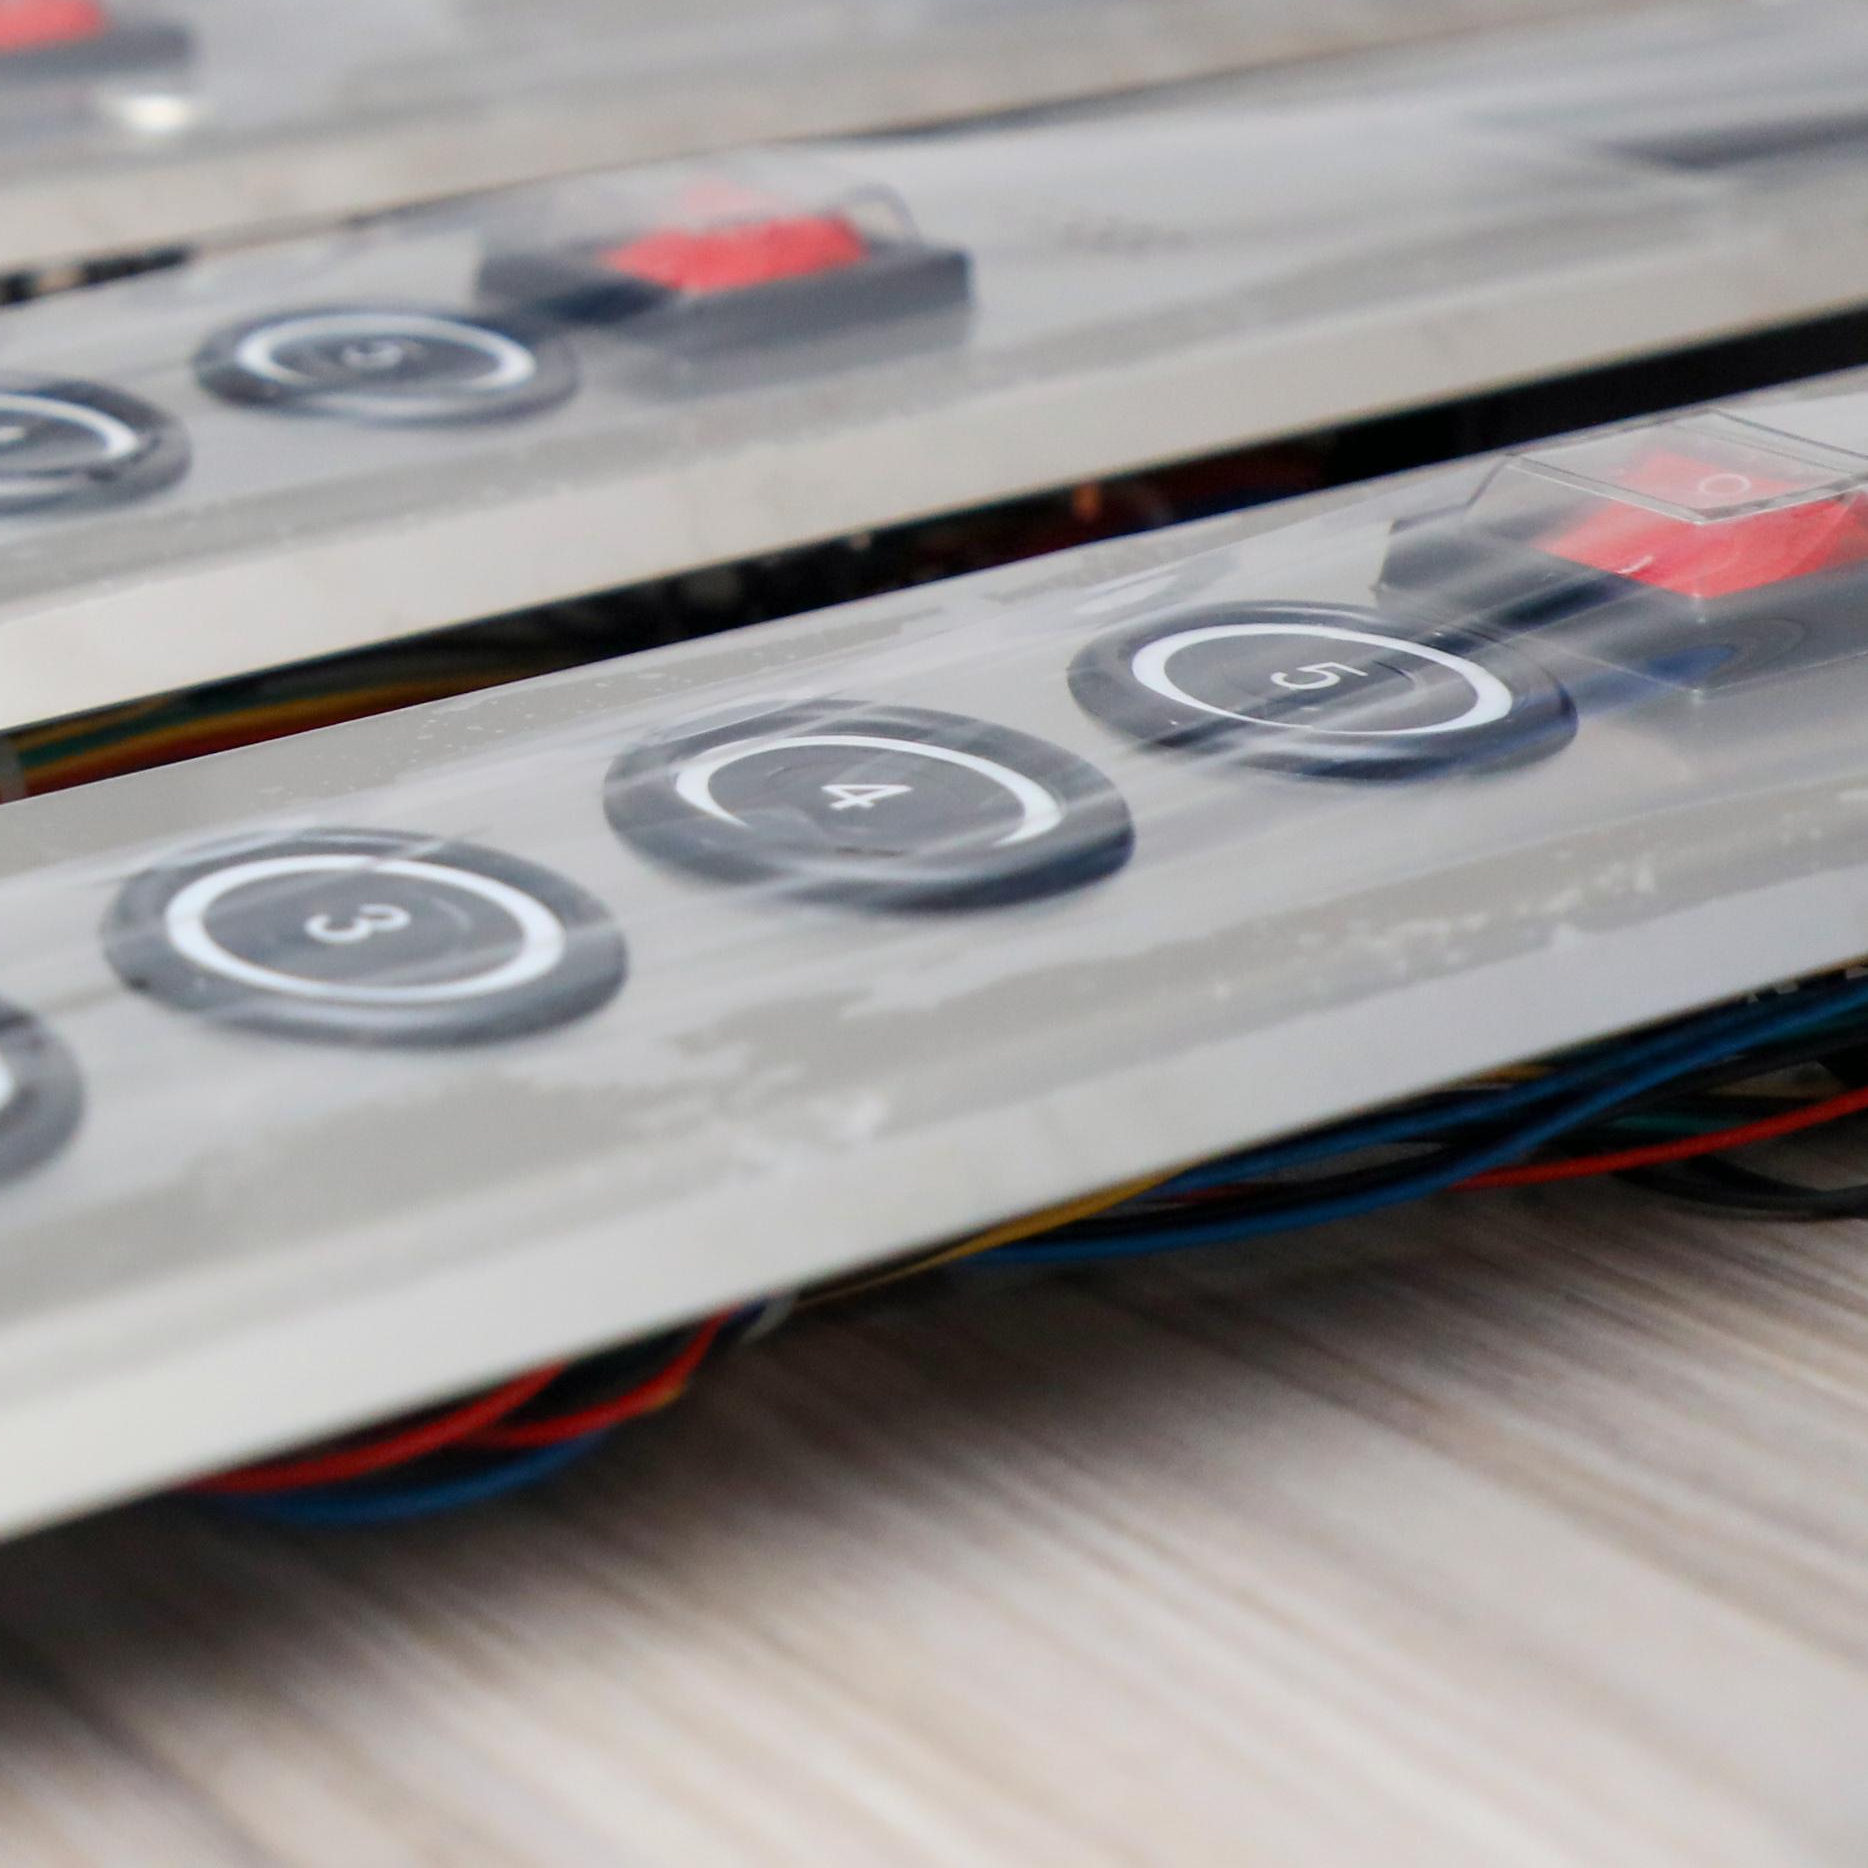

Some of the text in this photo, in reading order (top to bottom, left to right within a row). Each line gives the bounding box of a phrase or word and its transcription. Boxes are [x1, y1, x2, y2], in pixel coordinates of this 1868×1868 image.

[1270, 661, 1369, 690] 5
[820, 783, 913, 811] 4
[304, 903, 412, 943] 3
